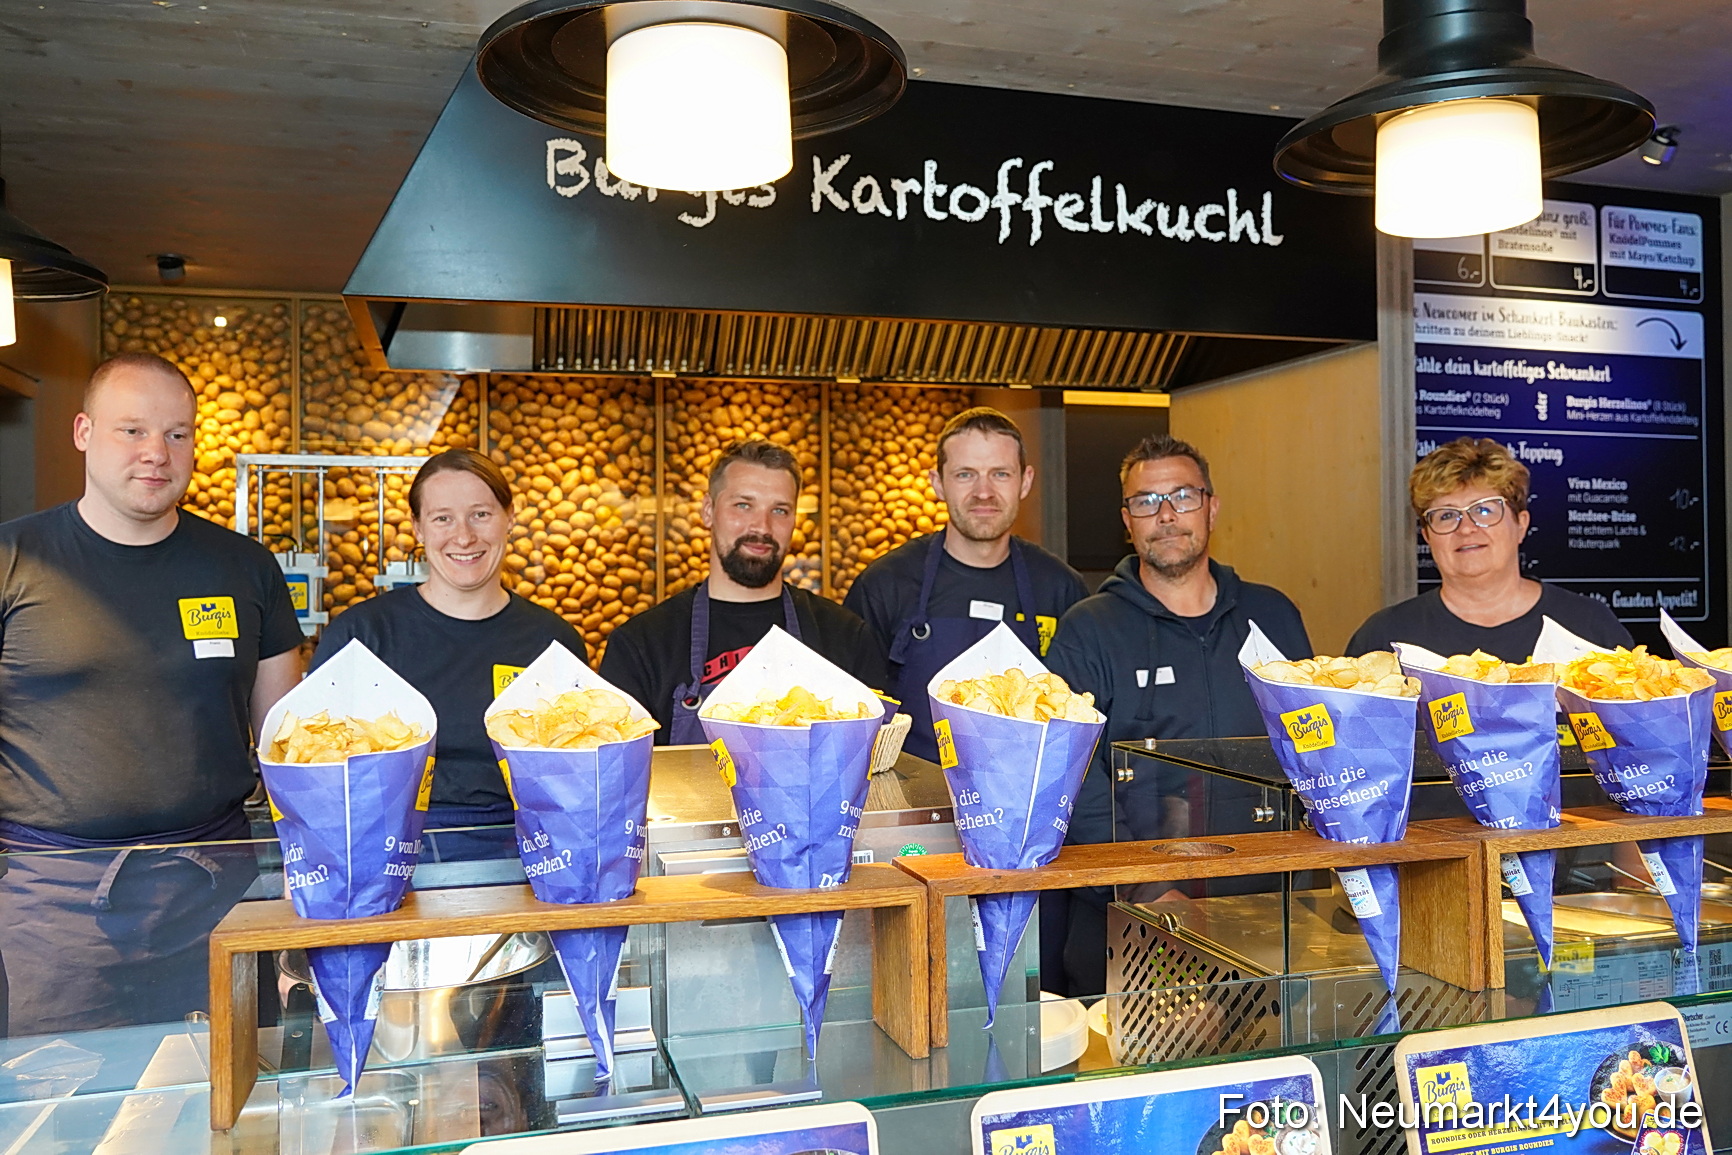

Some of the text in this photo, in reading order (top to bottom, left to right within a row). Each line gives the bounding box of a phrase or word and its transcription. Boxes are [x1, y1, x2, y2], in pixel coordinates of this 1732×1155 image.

[546, 138, 1284, 247] Bugs Kartoffelkuchl
[1423, 302, 1478, 321] Newcomer
[1415, 322, 1451, 336] hritten
[1453, 327, 1466, 336] zu
[1467, 326, 1505, 339] deinem
[1415, 355, 1443, 374] ähle
[1444, 356, 1472, 375] dein
[1473, 359, 1545, 385] kartoffeliges
[1534, 391, 1548, 421] oder
[1567, 477, 1628, 491] Viva Mexico
[1567, 493, 1582, 503] mit
[1567, 509, 1637, 522] Nordsee-Brise
[1567, 525, 1582, 535] mit
[1614, 525, 1639, 536] Lachs
[1568, 538, 1620, 550] Kräuterquark
[1612, 589, 1655, 608] Guaden
[1655, 589, 1698, 610] Appetit!
[186, 607, 232, 629] Burgis
[1433, 704, 1465, 730] Burgis
[1288, 715, 1329, 740] Burgis
[1574, 721, 1603, 741] Burgis
[1459, 759, 1479, 775] du
[1481, 749, 1508, 767] die
[1623, 763, 1651, 780] die
[1290, 766, 1366, 793] Hast du die
[1463, 761, 1534, 798] gesehen?
[960, 788, 980, 807] die
[1058, 794, 1069, 808] 9
[1314, 780, 1389, 814] gesehen?
[742, 807, 763, 828] die
[840, 800, 849, 815] 9
[624, 819, 634, 835] 9
[384, 836, 396, 851] 9
[523, 849, 573, 878] esehen?
[288, 863, 330, 891] ehen?
[1423, 1077, 1466, 1104] Burgis
[1431, 1133, 1467, 1145] ROUNDIES
[1467, 1130, 1487, 1140] ODER
